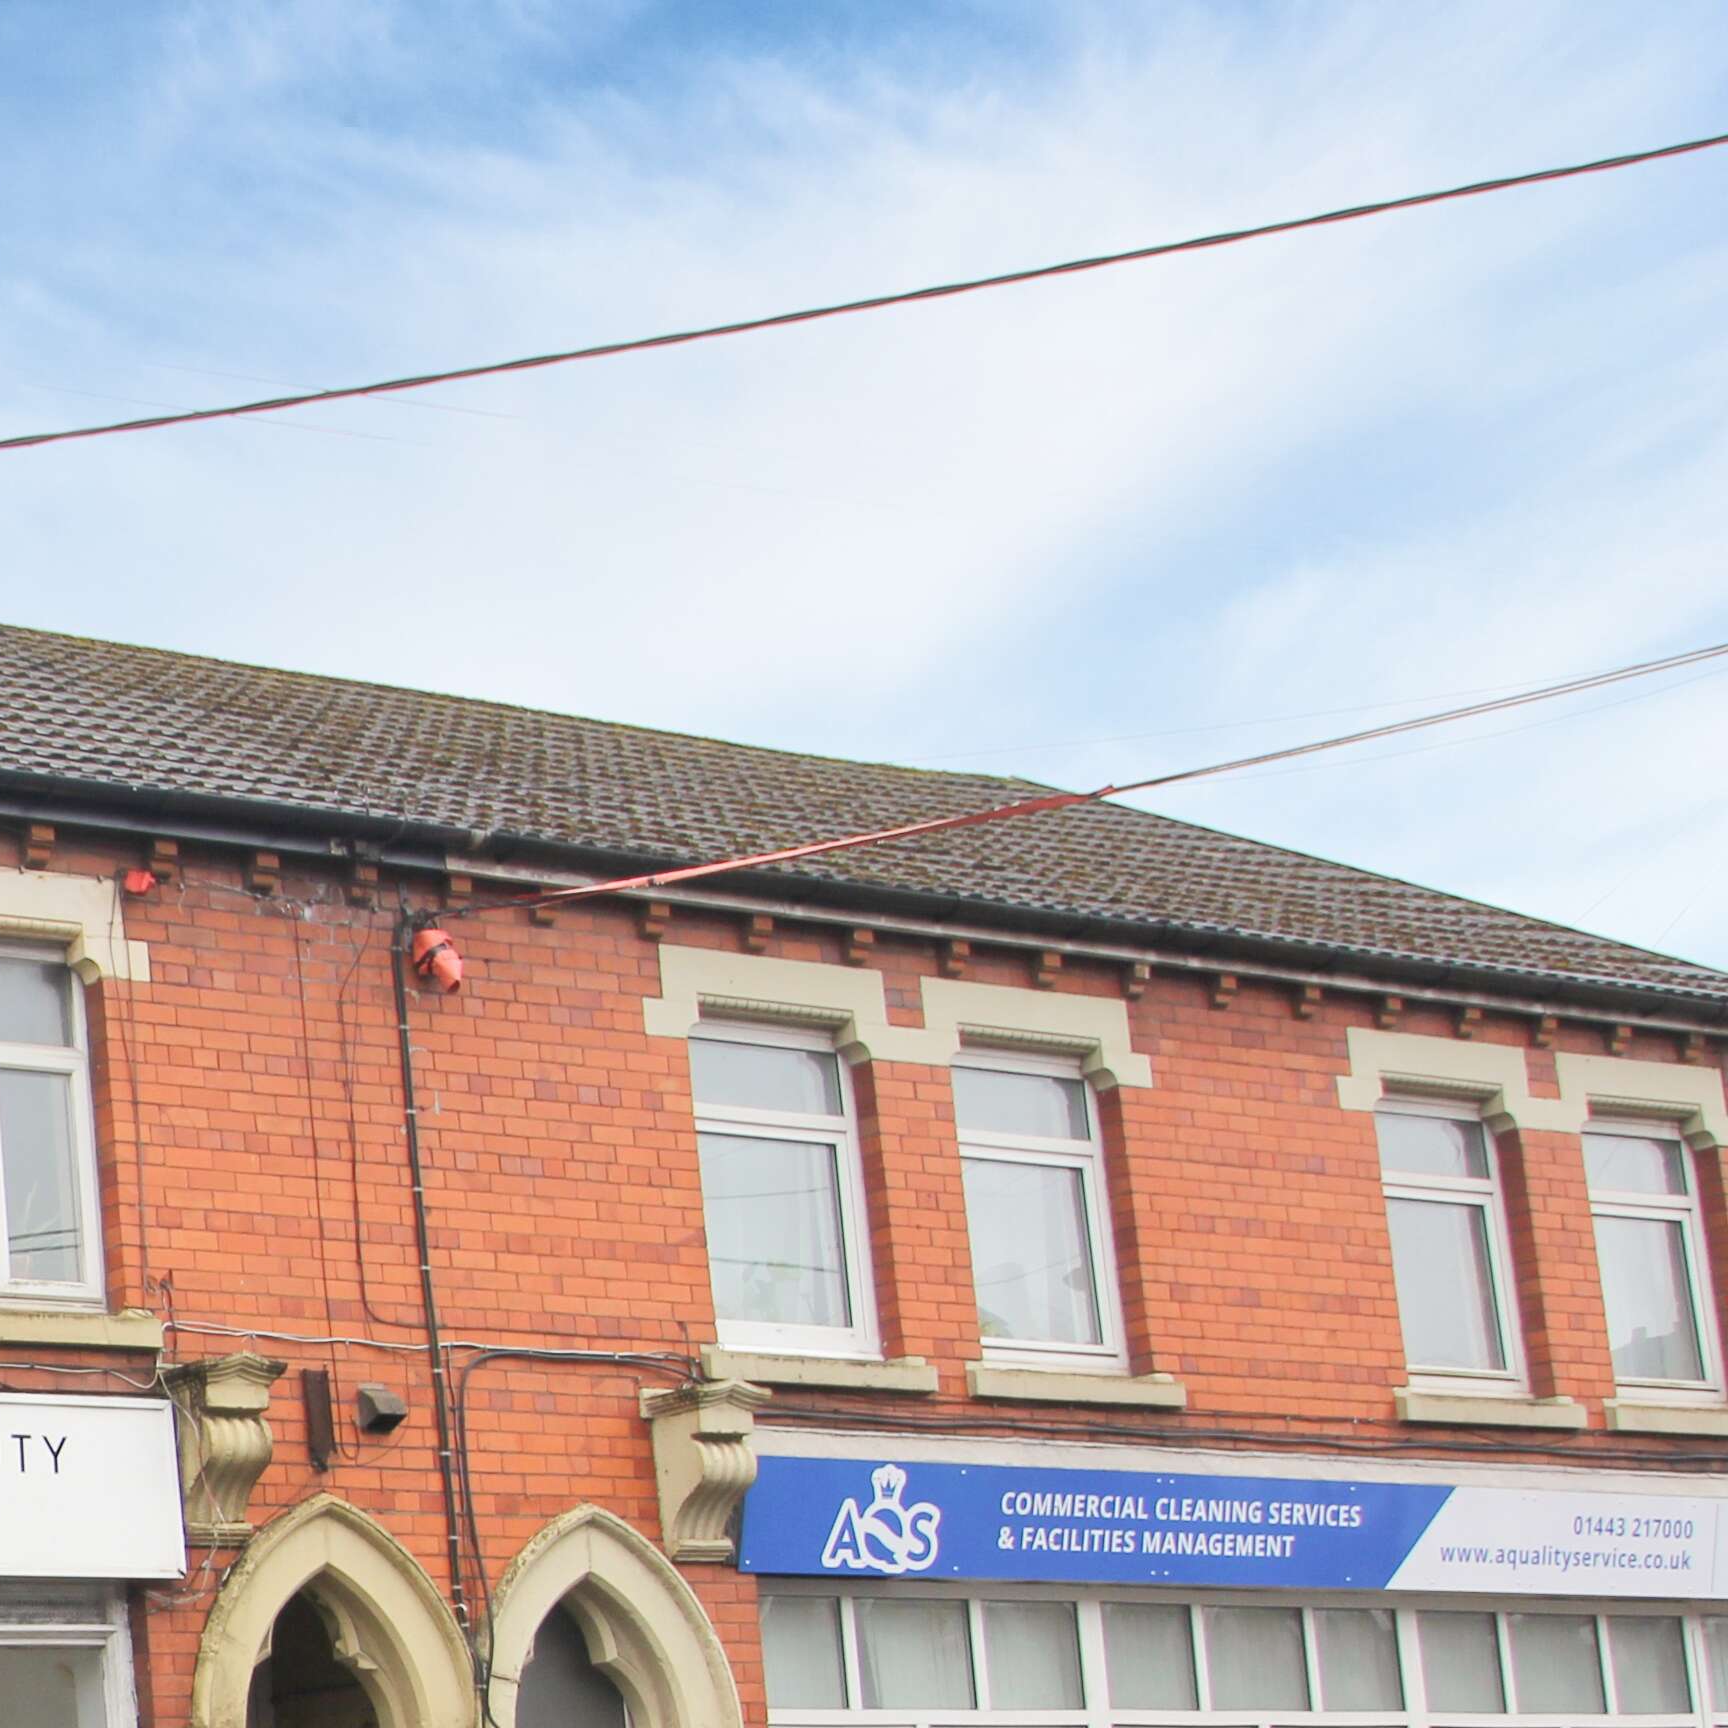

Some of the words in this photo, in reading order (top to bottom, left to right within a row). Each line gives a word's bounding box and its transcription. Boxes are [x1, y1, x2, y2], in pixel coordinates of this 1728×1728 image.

[1001, 1491, 1149, 1521] COMMERCIAL
[1155, 1496, 1265, 1524] CLEANING
[1269, 1500, 1362, 1528] SERVICES
[1573, 1516, 1625, 1537] 01443
[1632, 1518, 1694, 1539] 217000
[998, 1527, 1014, 1550] &
[1022, 1527, 1135, 1553] FACILITIES
[1143, 1530, 1295, 1558] MANAGEMENT
[1440, 1545, 1691, 1572] www.aqualityservice.co.uk
